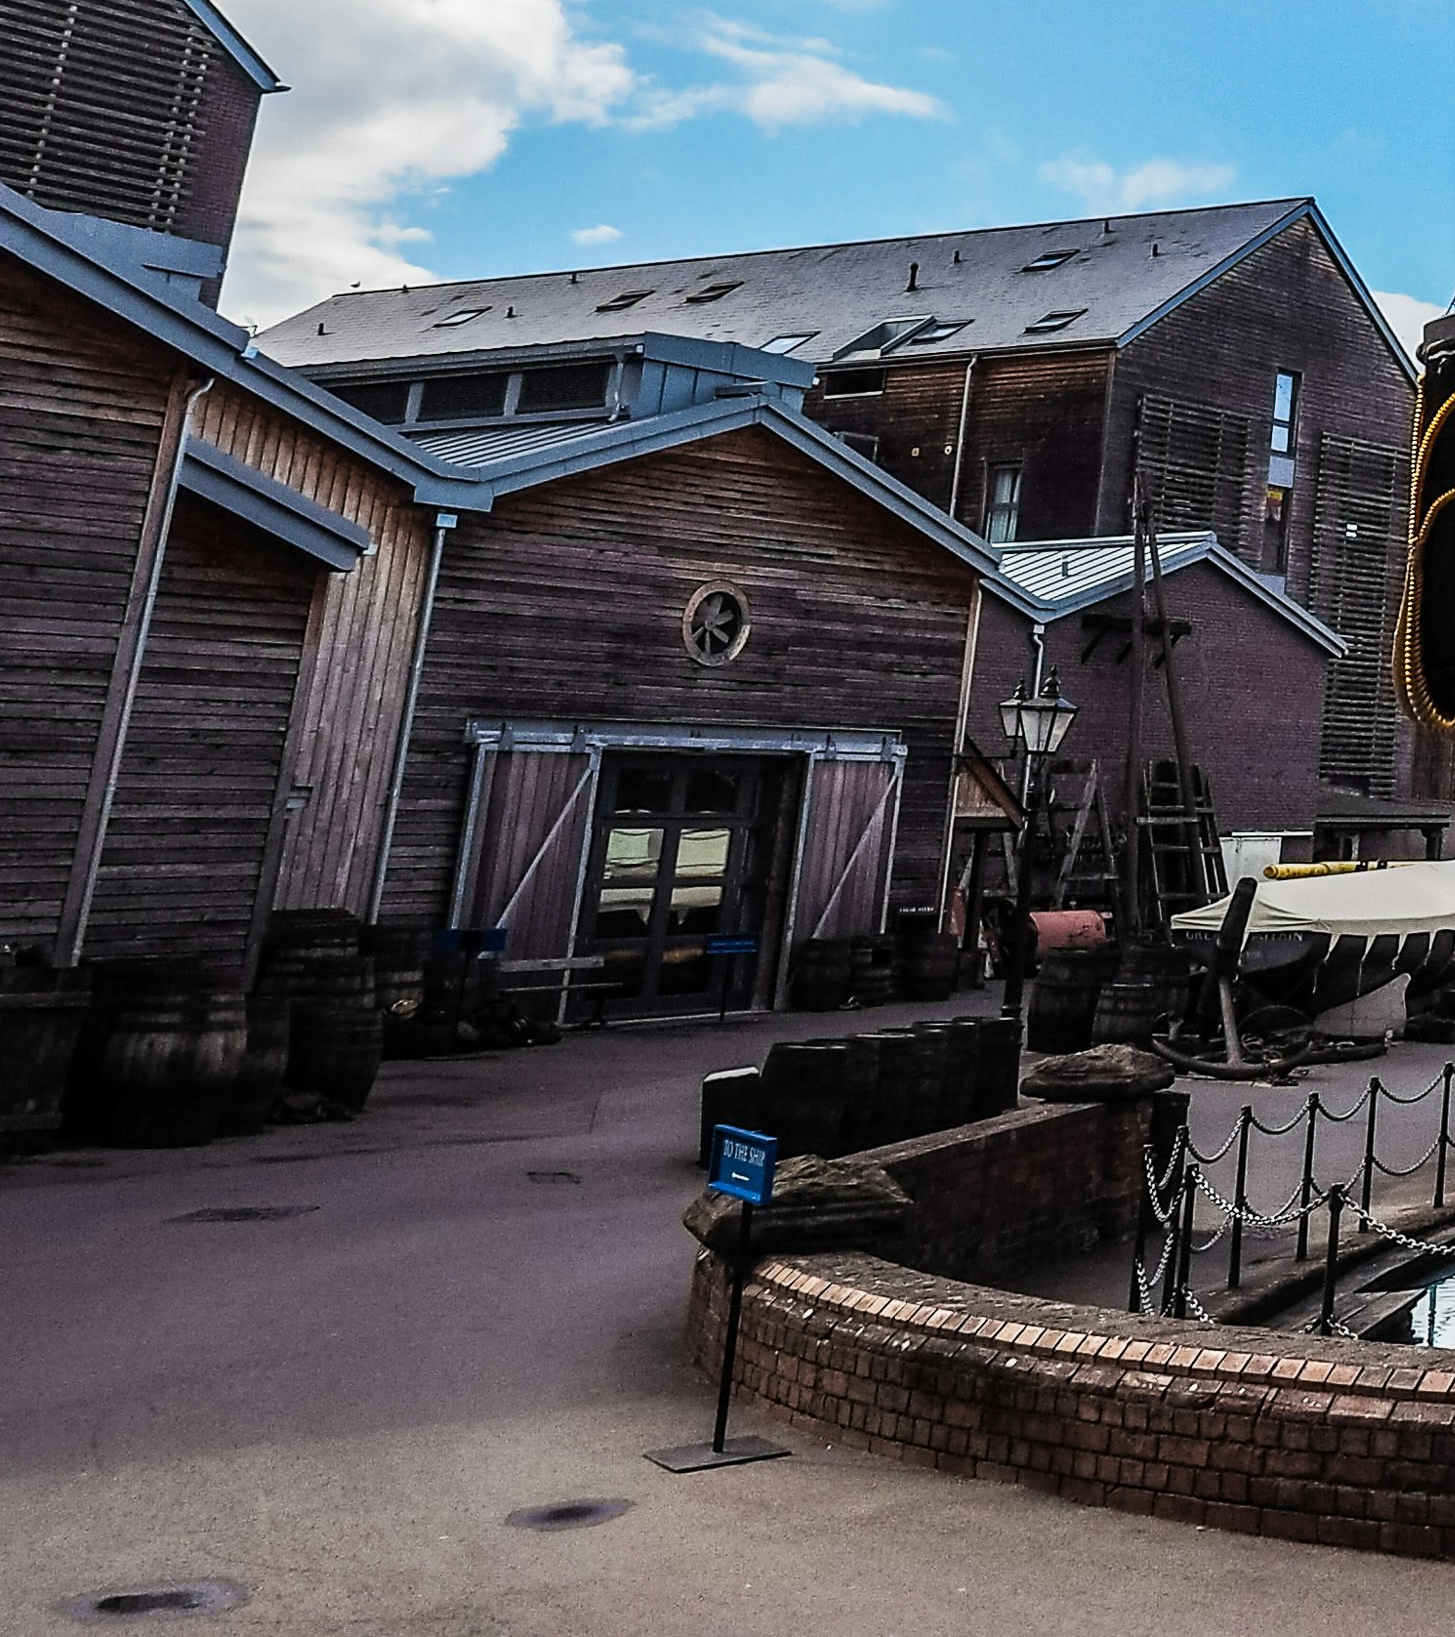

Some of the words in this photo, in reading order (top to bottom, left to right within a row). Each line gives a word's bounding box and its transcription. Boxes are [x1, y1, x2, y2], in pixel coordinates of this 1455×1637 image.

[723, 1139, 734, 1158] TO
[734, 1143, 748, 1162] THE
[748, 1147, 766, 1167] SHIP
